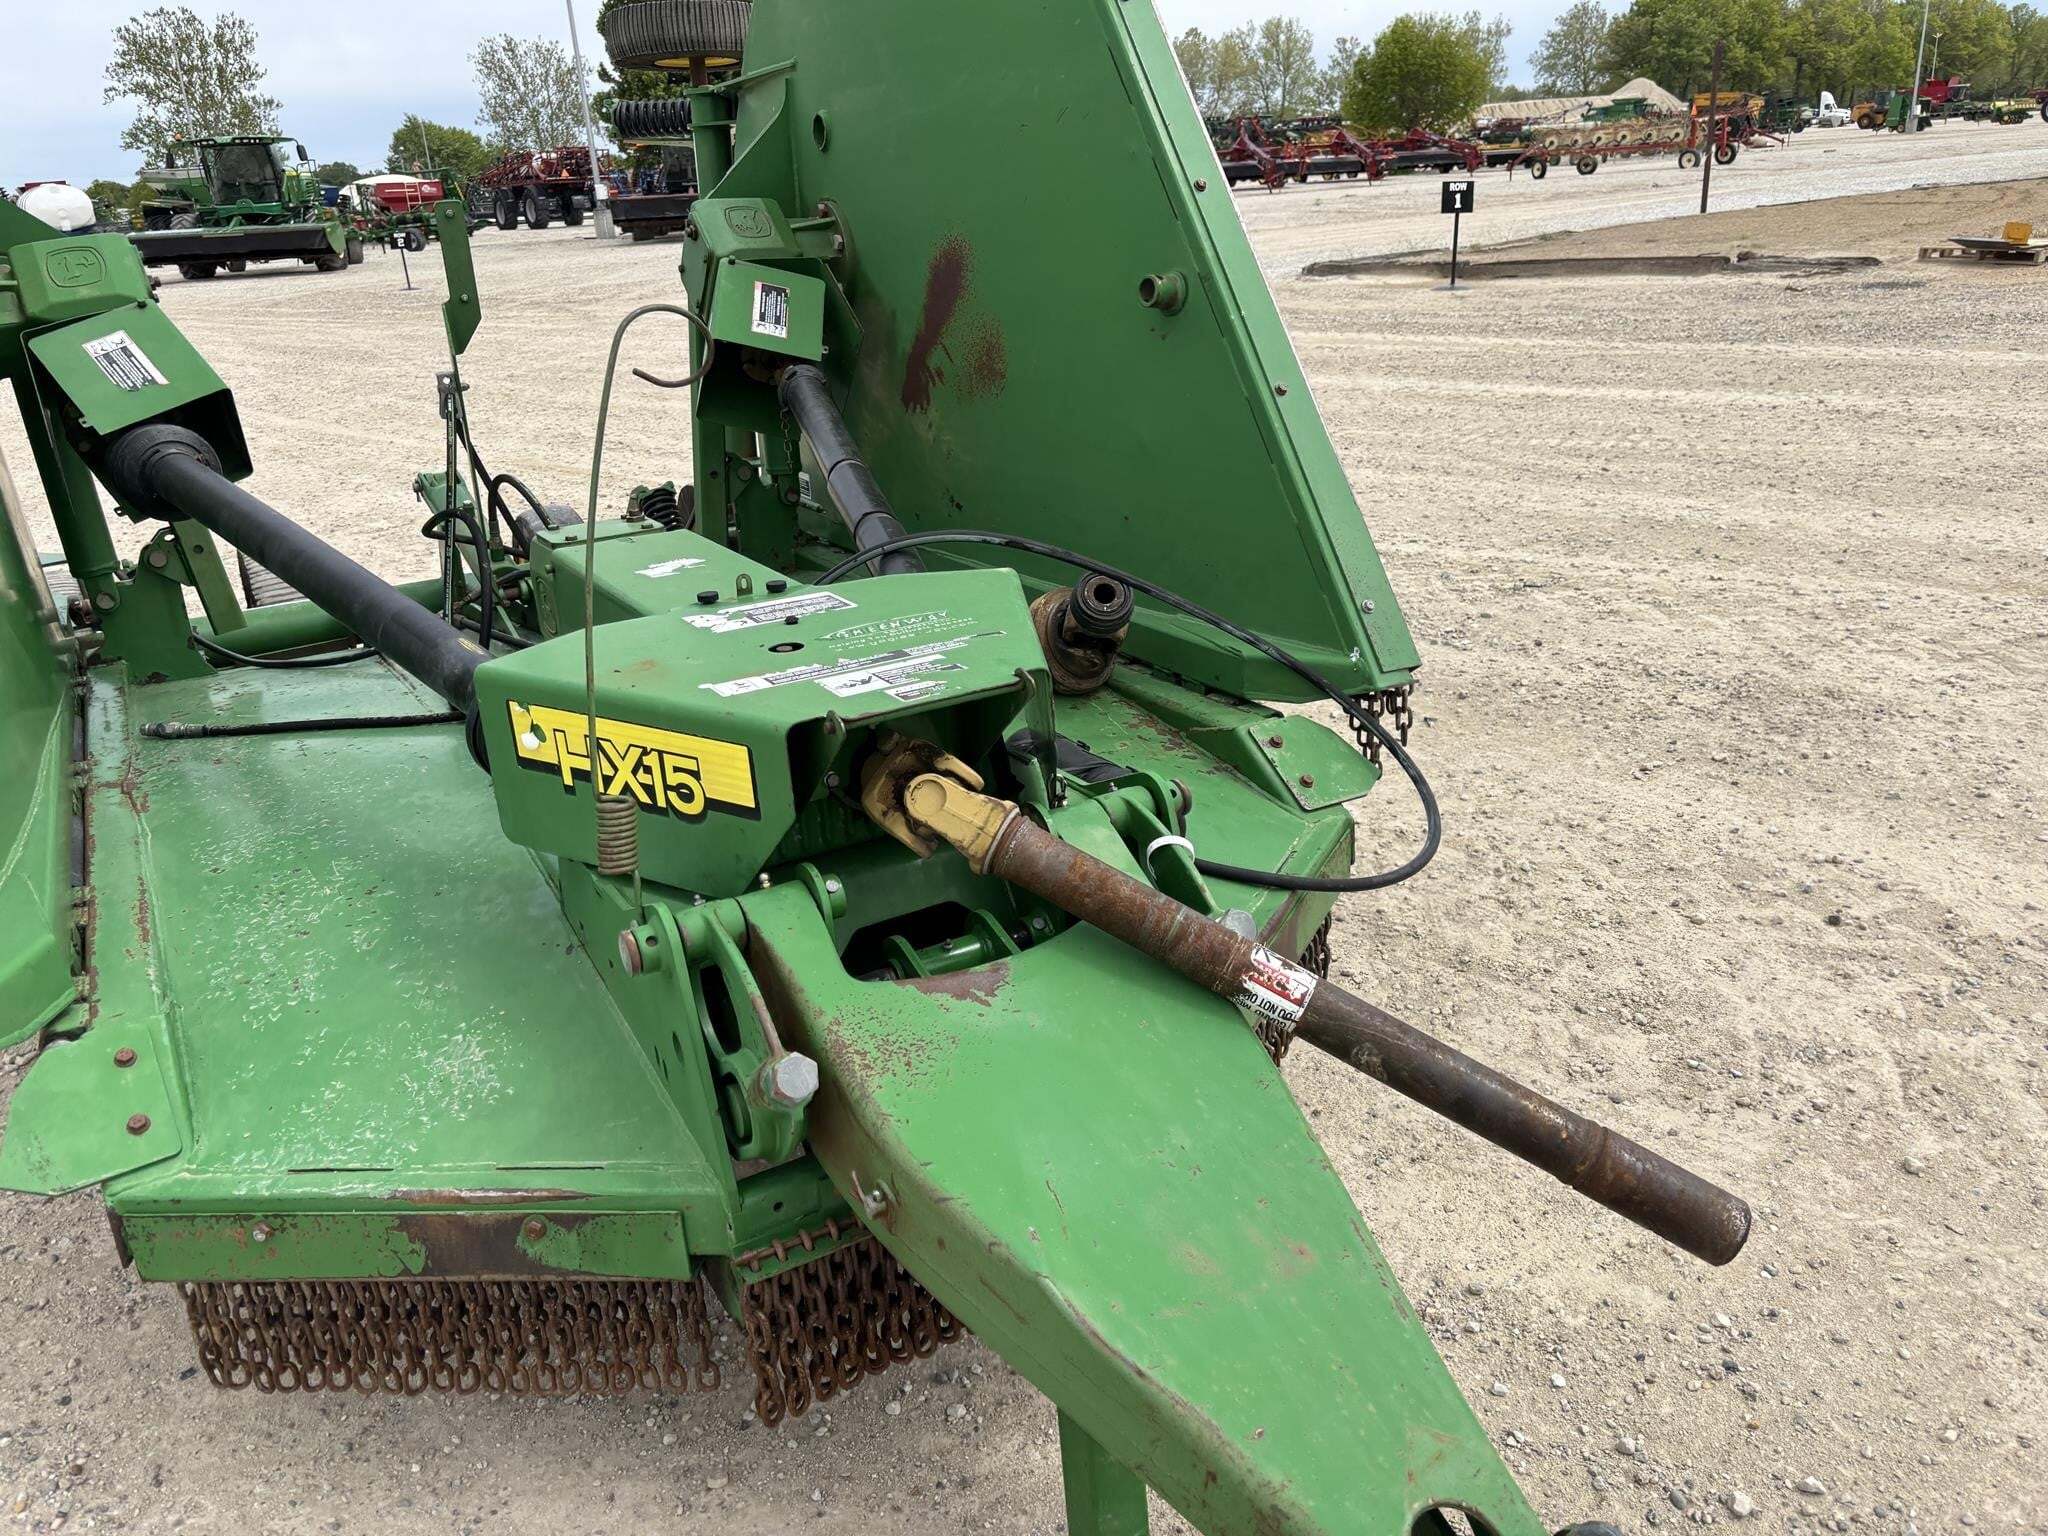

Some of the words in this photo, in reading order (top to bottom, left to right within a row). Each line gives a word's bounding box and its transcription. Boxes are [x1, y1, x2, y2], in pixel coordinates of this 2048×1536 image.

[1449, 182, 1468, 191] ROW
[1454, 192, 1462, 208] 1
[397, 238, 405, 247] 2
[553, 729, 706, 820] HX15
[1257, 997, 1279, 1015] NOT
